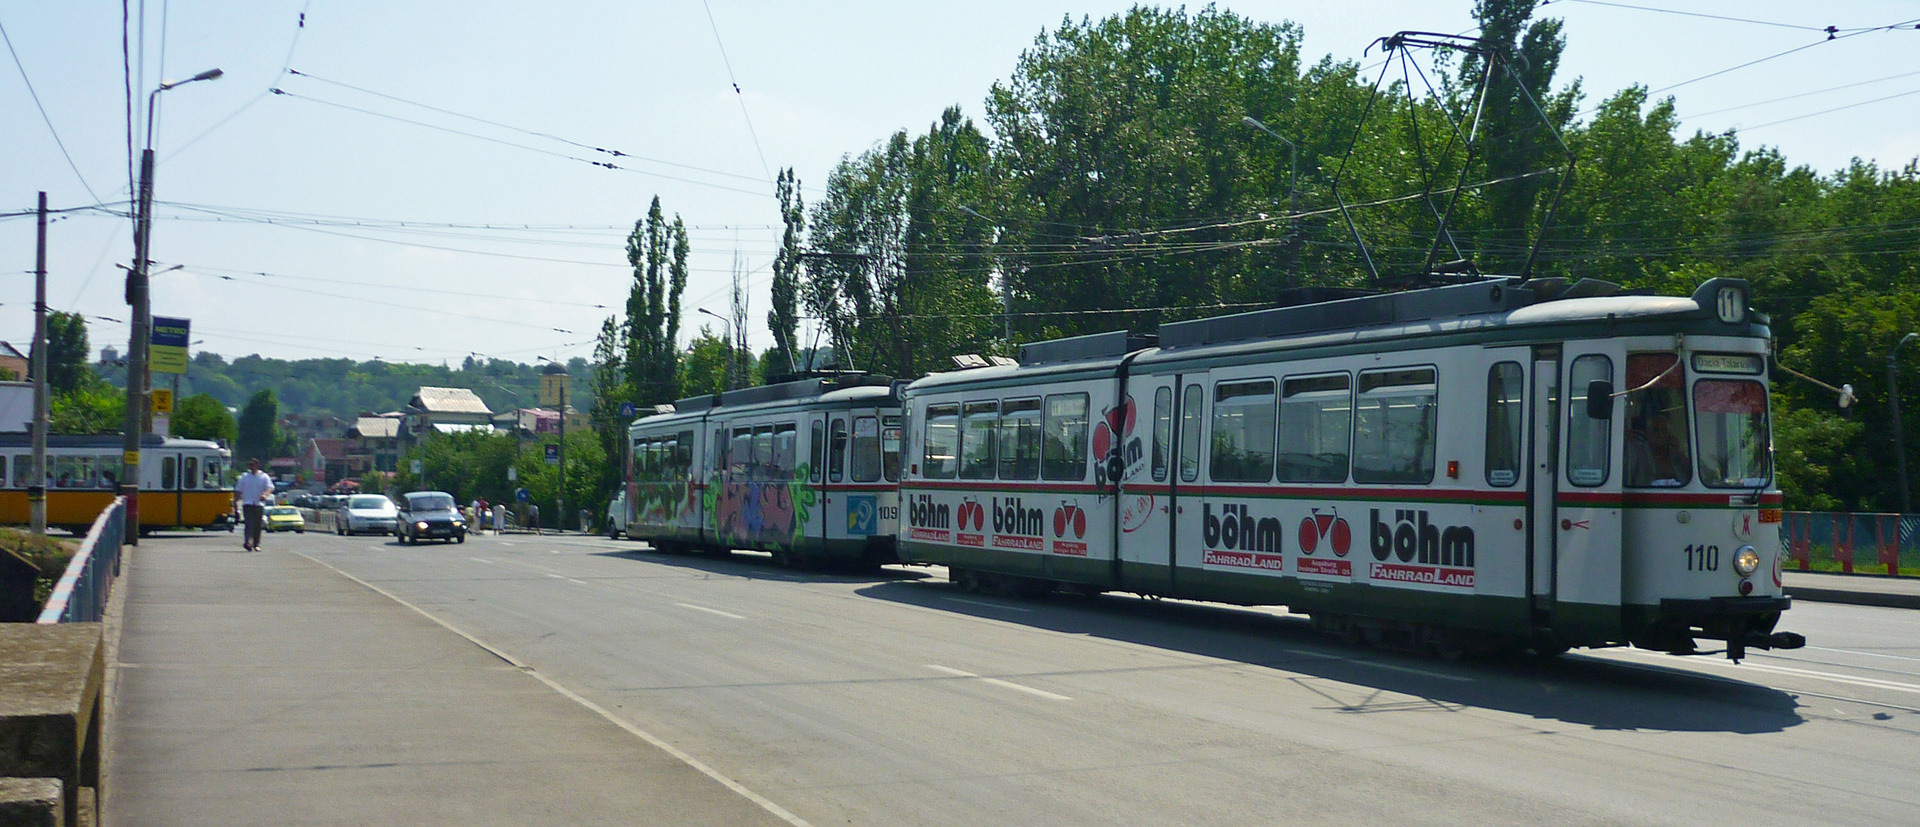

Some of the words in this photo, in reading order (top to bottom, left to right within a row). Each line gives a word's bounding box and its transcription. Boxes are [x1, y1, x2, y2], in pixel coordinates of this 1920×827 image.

[1720, 290, 1735, 318] 11
[878, 506, 898, 520] 109
[909, 494, 950, 529] böhm
[992, 496, 1044, 536] böhm
[1203, 502, 1283, 553] böhm
[1370, 508, 1475, 568] böhm
[1684, 544, 1719, 571] 110
